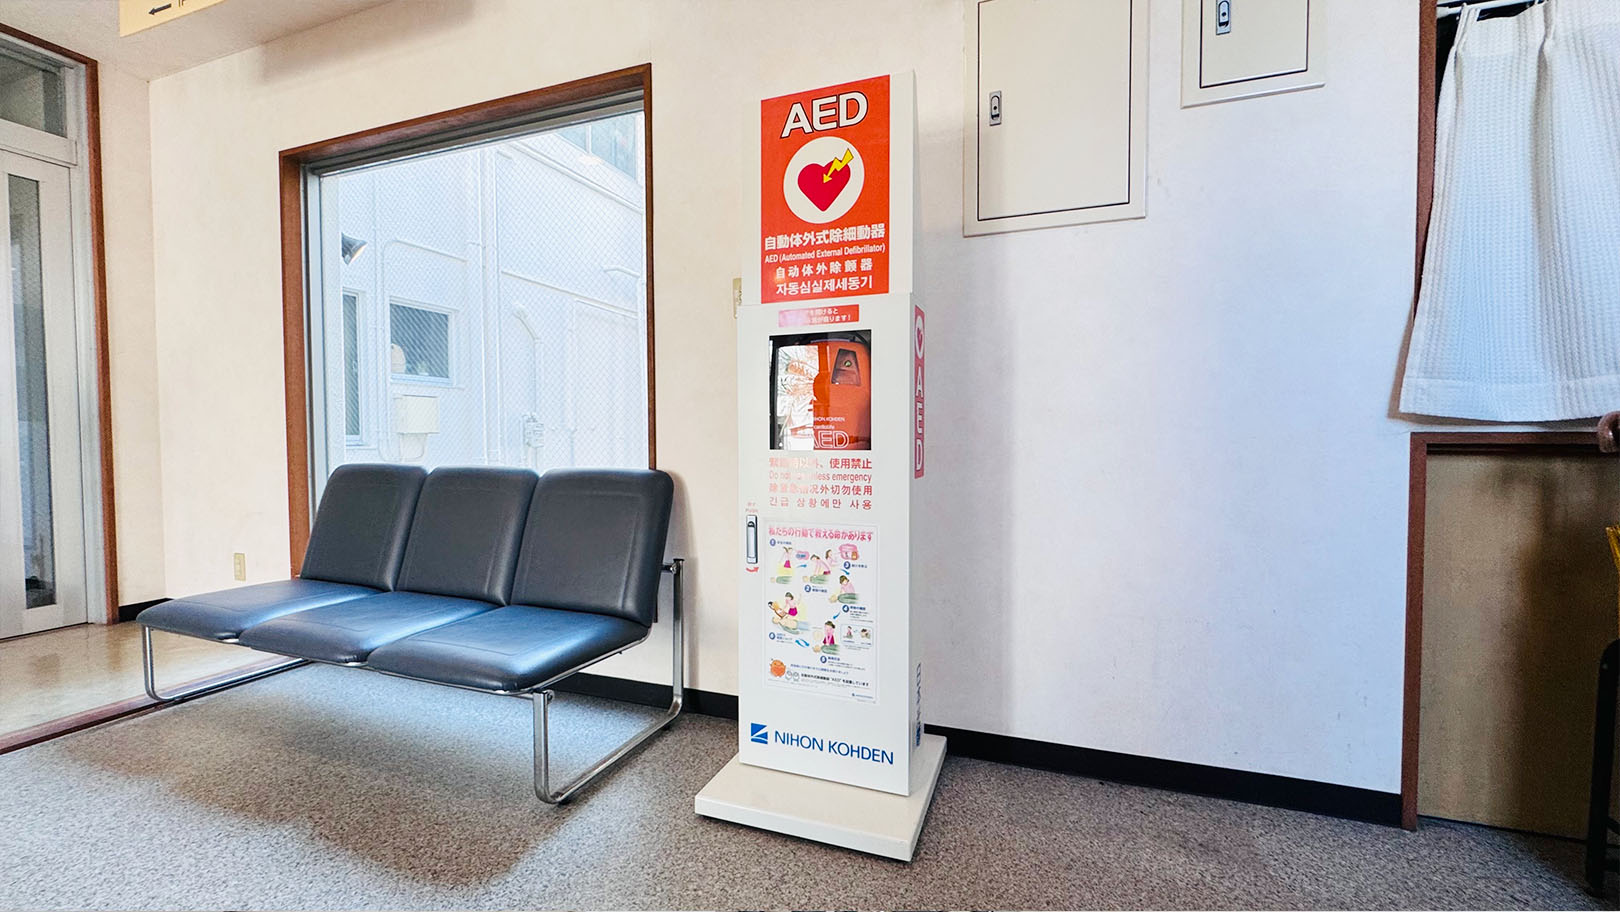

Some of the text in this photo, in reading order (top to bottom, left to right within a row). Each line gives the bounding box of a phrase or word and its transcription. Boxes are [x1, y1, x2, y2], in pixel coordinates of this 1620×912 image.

[780, 91, 869, 139] AED
[764, 223, 886, 250] 自動体外式除細動器
[765, 242, 886, 263] AED (Automated External Defibrillator)
[776, 275, 873, 296] 자동심실제세동기
[915, 365, 924, 471] AED
[831, 473, 872, 484] emergency
[850, 499, 872, 511] 사용
[774, 730, 894, 765] NIHON KOHDEN
